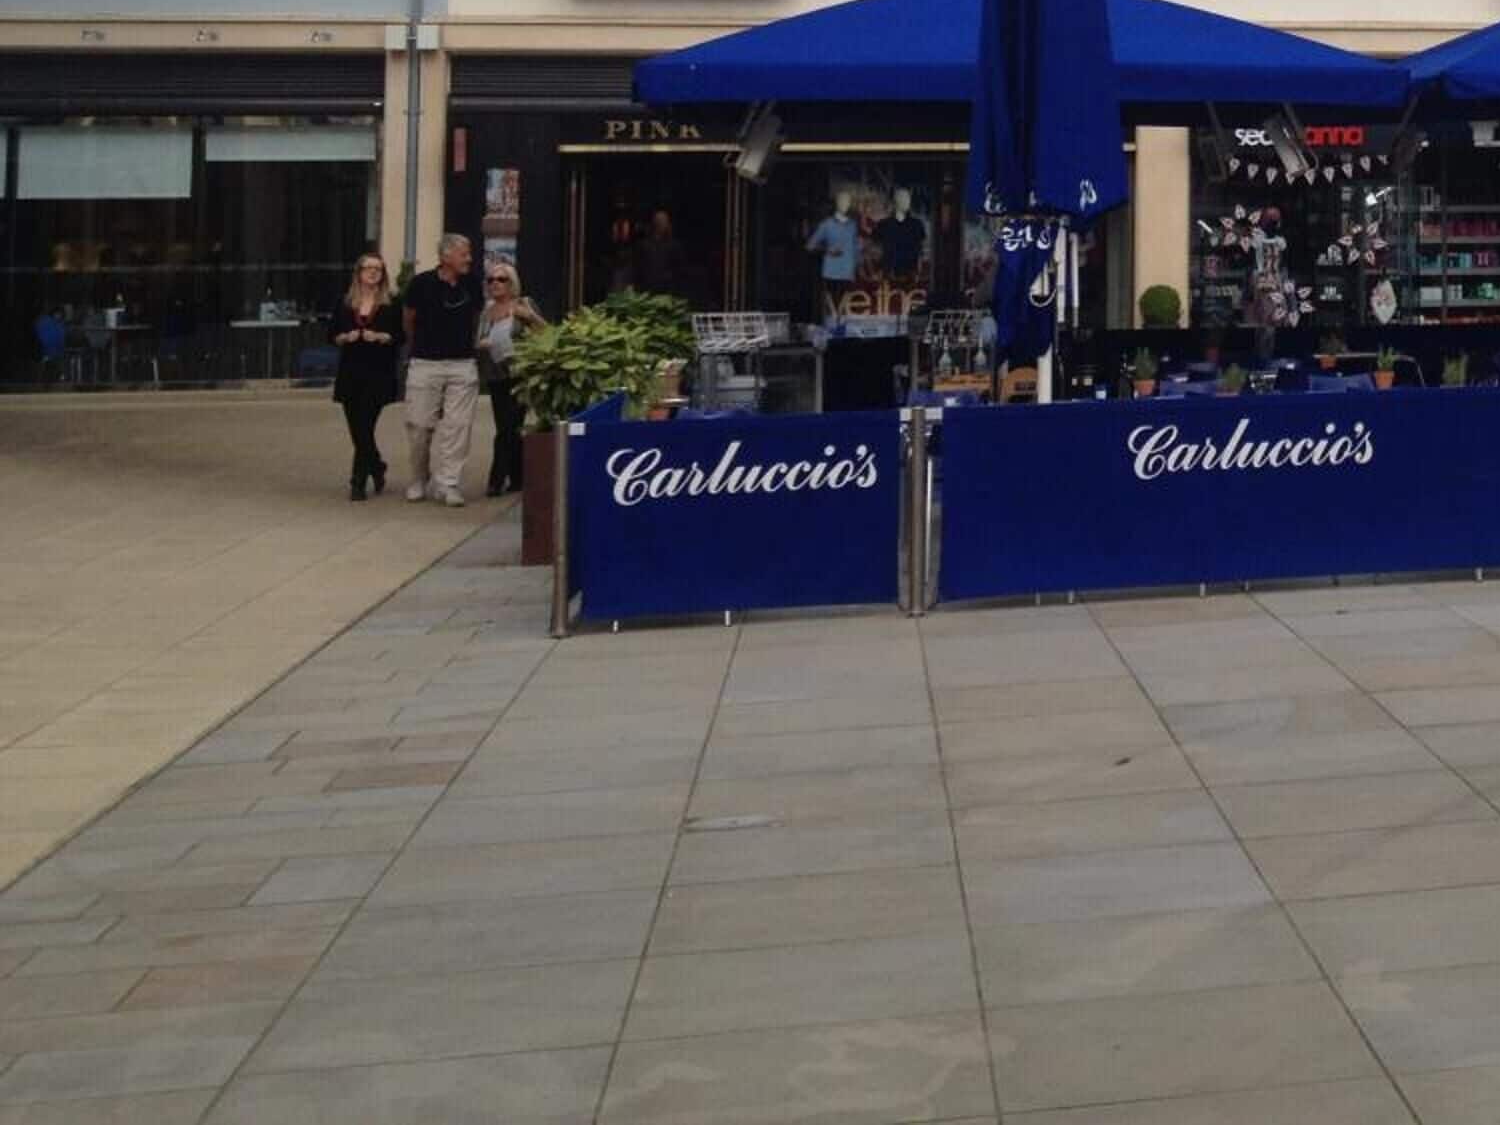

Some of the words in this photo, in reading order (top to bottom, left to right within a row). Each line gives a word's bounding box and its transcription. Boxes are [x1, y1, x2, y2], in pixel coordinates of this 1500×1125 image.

[605, 119, 702, 140] PINK
[605, 440, 877, 507] Carluccio's
[1127, 418, 1374, 481] Carluccio's
